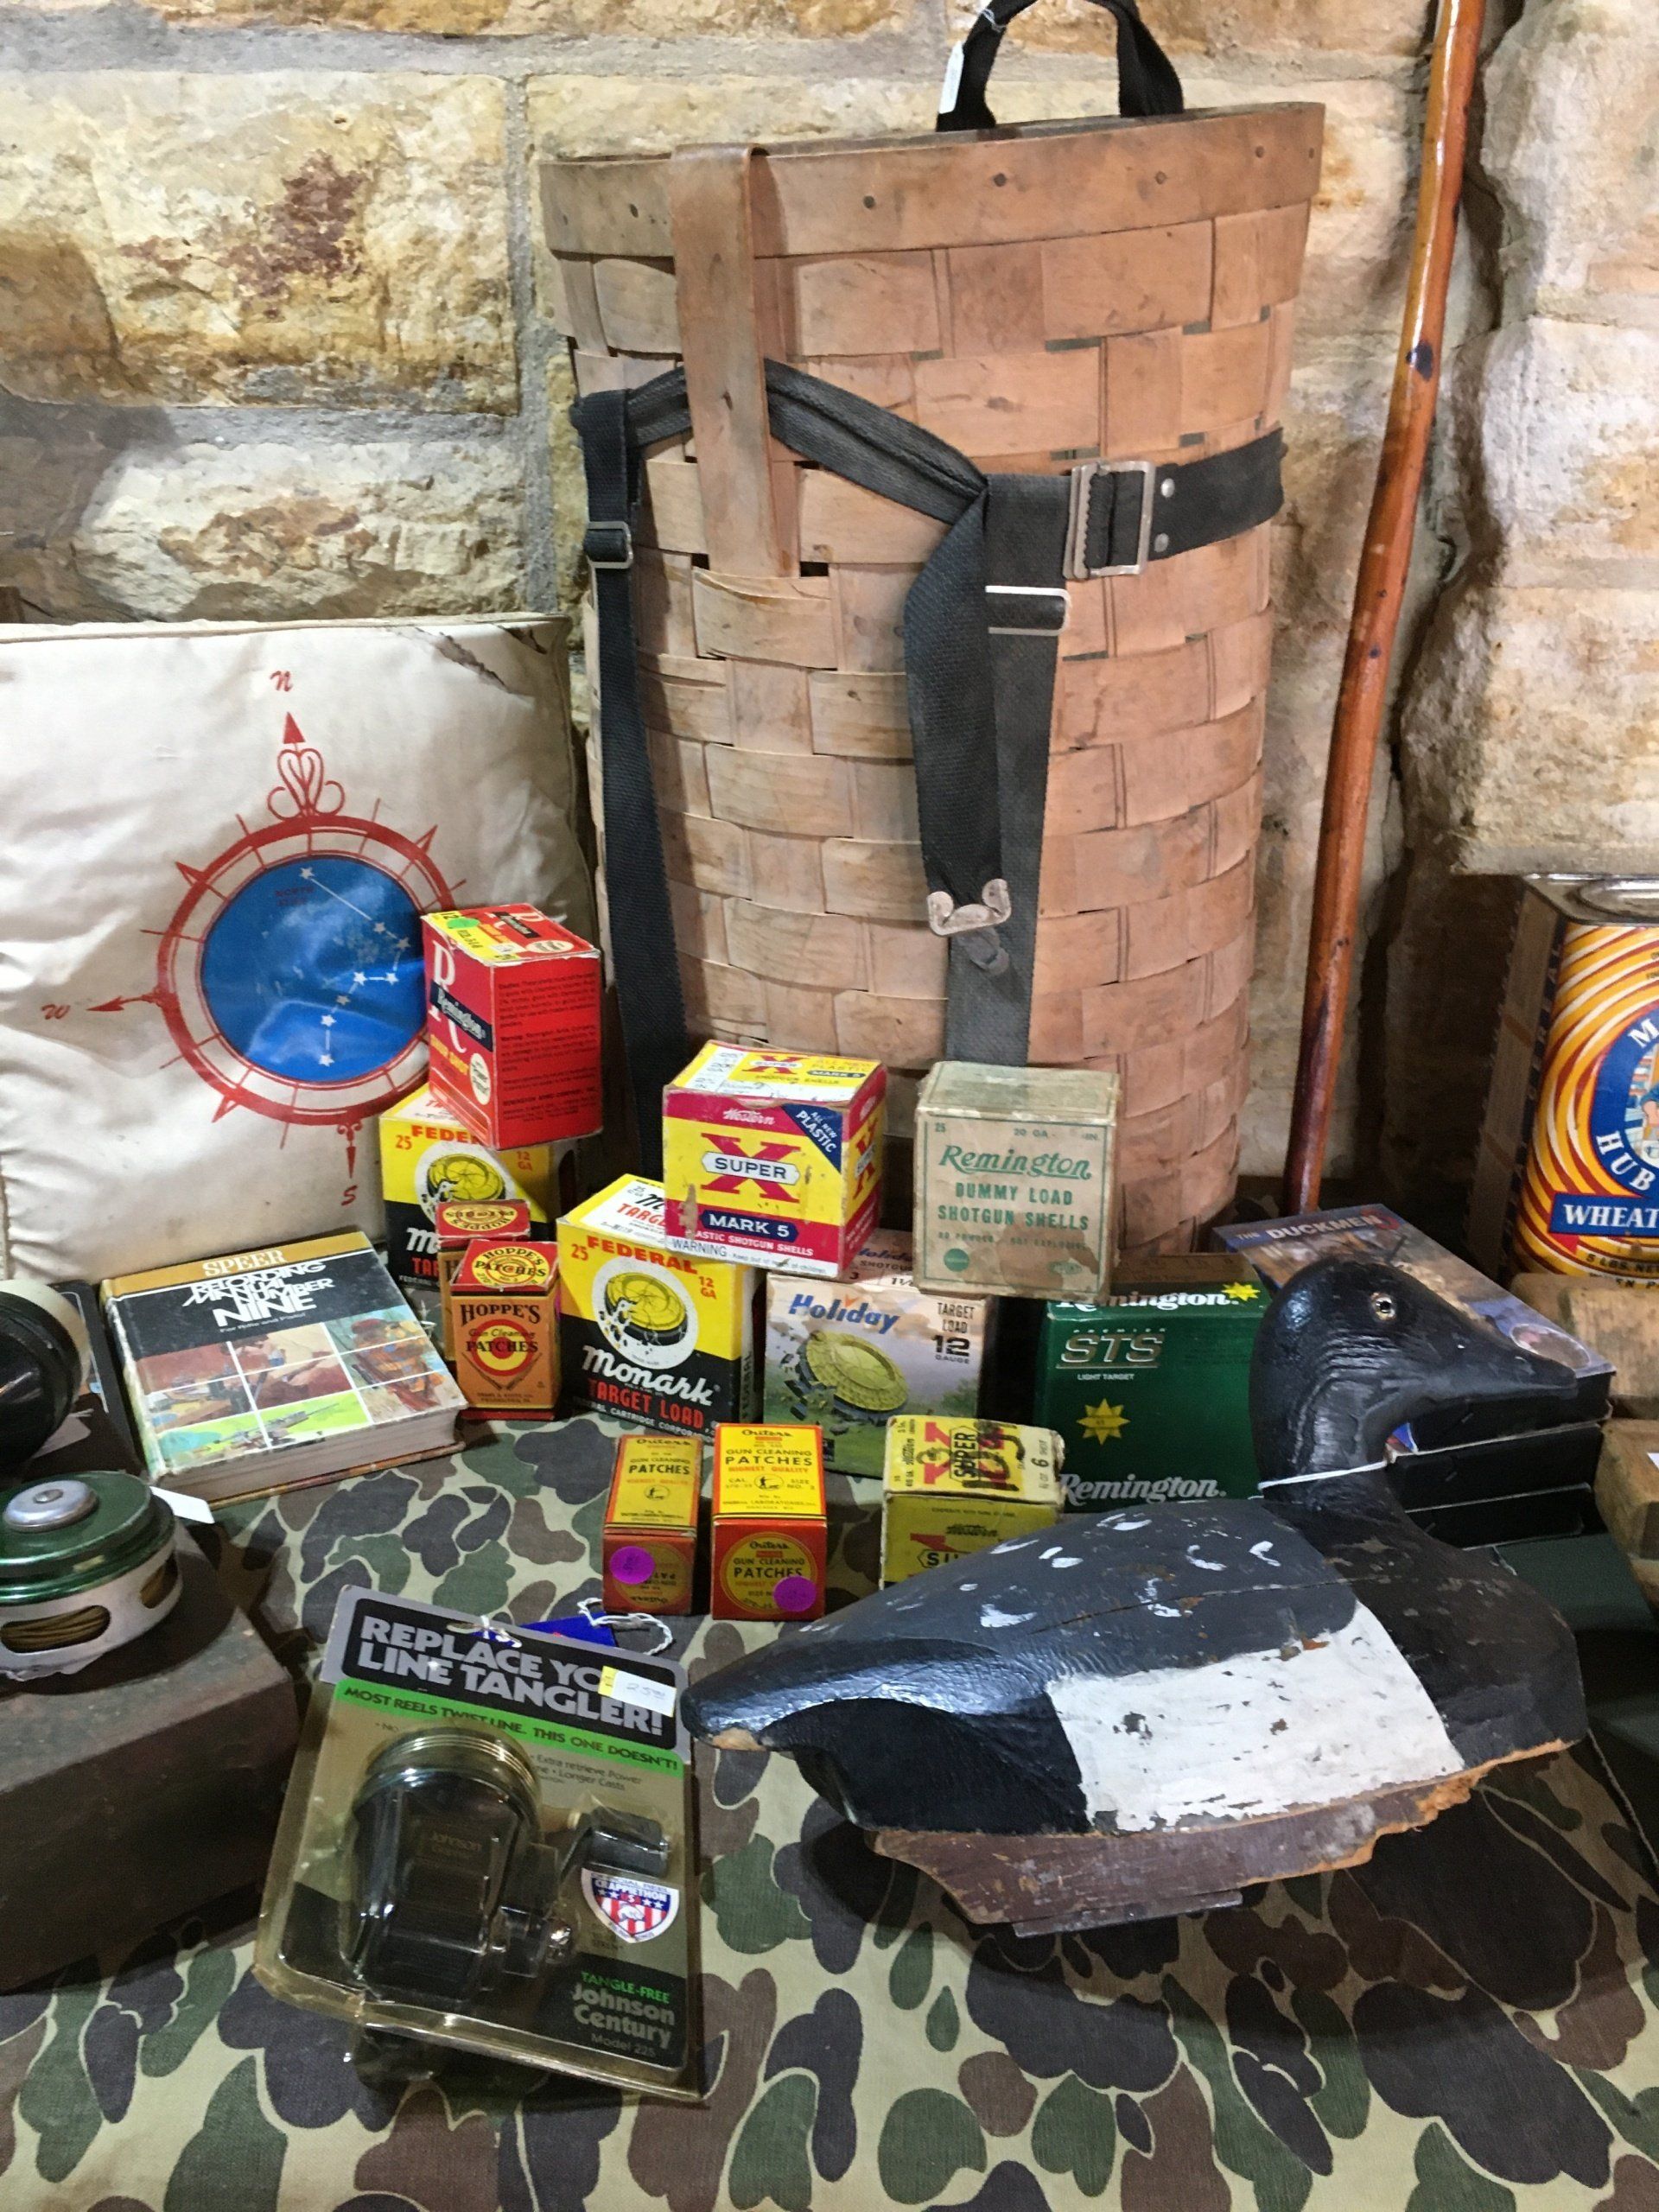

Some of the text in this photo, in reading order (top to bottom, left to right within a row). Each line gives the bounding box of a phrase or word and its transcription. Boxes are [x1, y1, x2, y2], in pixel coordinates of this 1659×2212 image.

[722, 1108, 776, 1126] Western
[395, 1135, 413, 1151] 25
[796, 1109, 837, 1153] PLASTIC
[701, 1132, 801, 1204] X
[714, 1157, 787, 1180] SUPER
[938, 1144, 1092, 1180] Remington
[955, 1182, 1073, 1205] DUMMY LOAD
[709, 1213, 790, 1237] MARK 5
[938, 1205, 1089, 1230] SHOTGUN SHELLS
[1266, 1215, 1382, 1239] DUCKMEN
[571, 1243, 588, 1261] 25
[587, 1236, 697, 1275] FEDERAL
[672, 1238, 728, 1257] WARNING
[728, 1235, 774, 1250] SHOTGUN
[778, 1243, 814, 1256] SHELLS
[202, 1249, 288, 1278] SPEER
[190, 1261, 327, 1294] RELOADING
[699, 1275, 714, 1287] 12
[213, 1296, 318, 1327] NINE
[461, 1303, 542, 1328] HOPPE'S
[788, 1293, 900, 1335] Holiday
[938, 1302, 975, 1320] TARGET
[942, 1319, 968, 1333] LOAD
[466, 1340, 538, 1353] PATCHES
[931, 1335, 969, 1357] 12
[1060, 1333, 1165, 1363] STS
[588, 1378, 652, 1414] TARGET
[660, 1400, 704, 1429] LOAD
[628, 1464, 690, 1475] PATCHES
[725, 1456, 813, 1466] PATCHES
[734, 1567, 803, 1579] PATCHES
[360, 1616, 603, 1693] REPLACE YO
[358, 1641, 663, 1737] LINE TANGLER!
[344, 1687, 392, 1707] MOST
[393, 1698, 438, 1715] REELS
[441, 1707, 489, 1722] TWIST
[533, 1726, 566, 1744] THIS
[570, 1736, 604, 1751] ONE
[607, 1745, 678, 1770] DOESN'T!
[571, 1982, 675, 2026] Johnson
[574, 2004, 671, 2050] Century
